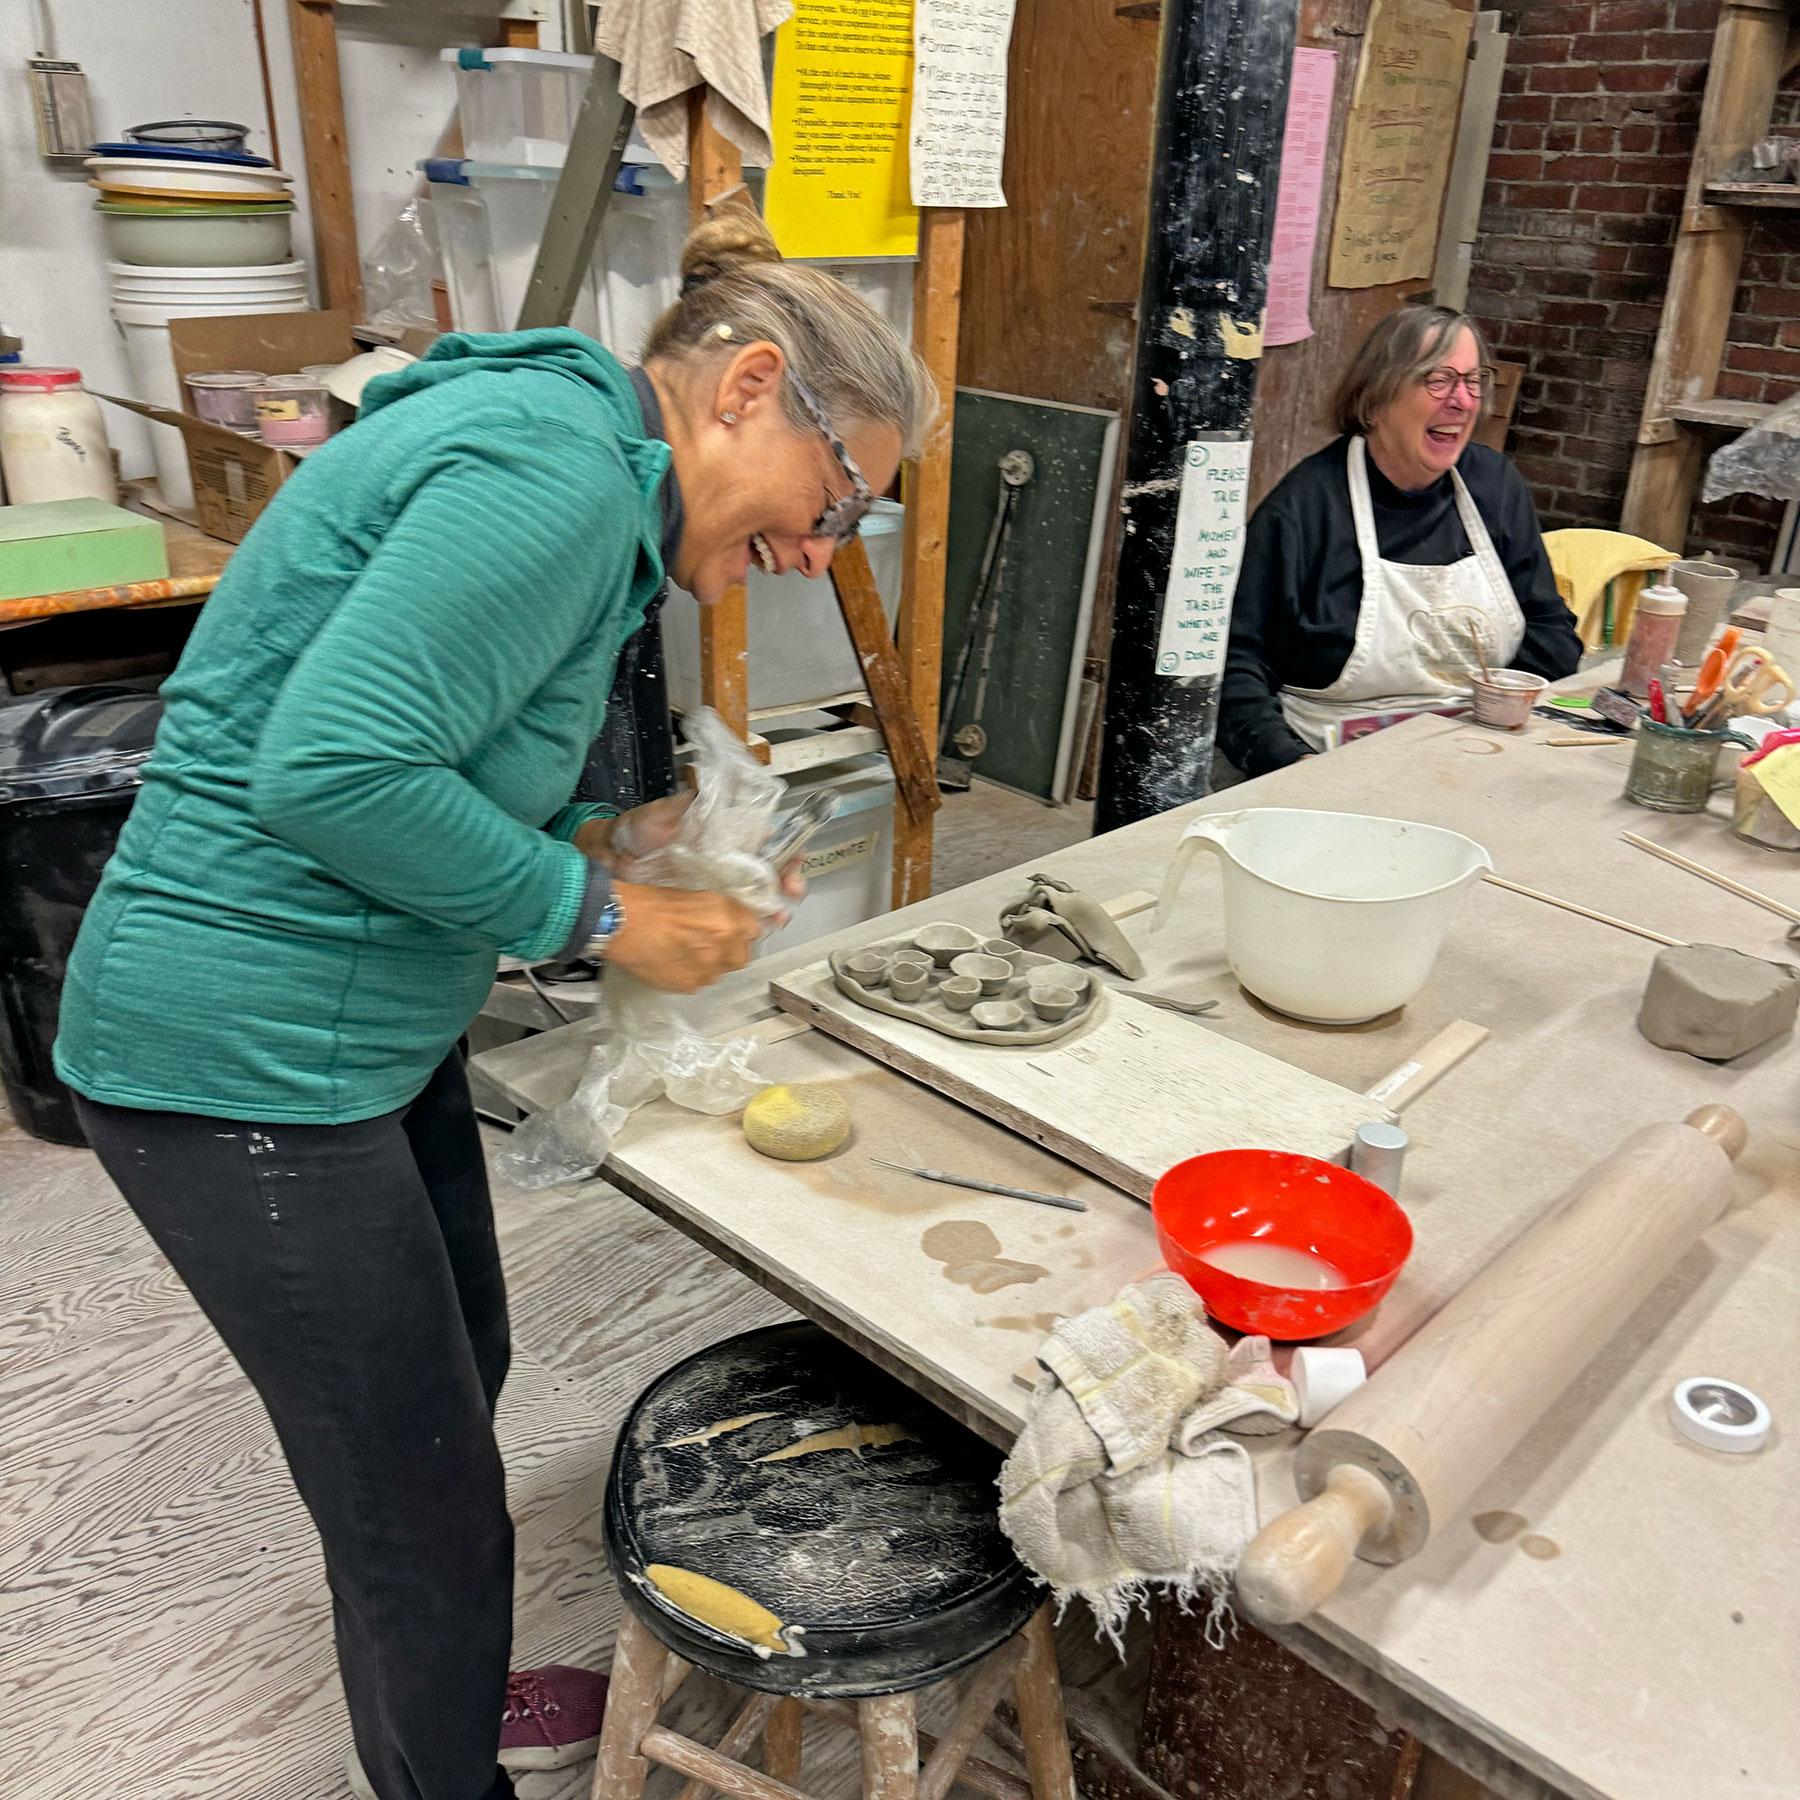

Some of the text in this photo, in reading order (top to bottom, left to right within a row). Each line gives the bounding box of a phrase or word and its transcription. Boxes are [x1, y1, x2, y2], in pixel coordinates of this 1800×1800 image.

[1205, 467, 1246, 482] PLEASE
[1211, 489, 1241, 503] TAKE
[1218, 507, 1230, 521] A
[1205, 548, 1229, 559] AND
[1201, 582, 1224, 595] THE
[1184, 597, 1227, 612] TABLE
[1177, 617, 1213, 629] WHEN
[1199, 631, 1221, 643] ARE
[1184, 649, 1216, 661] DONE
